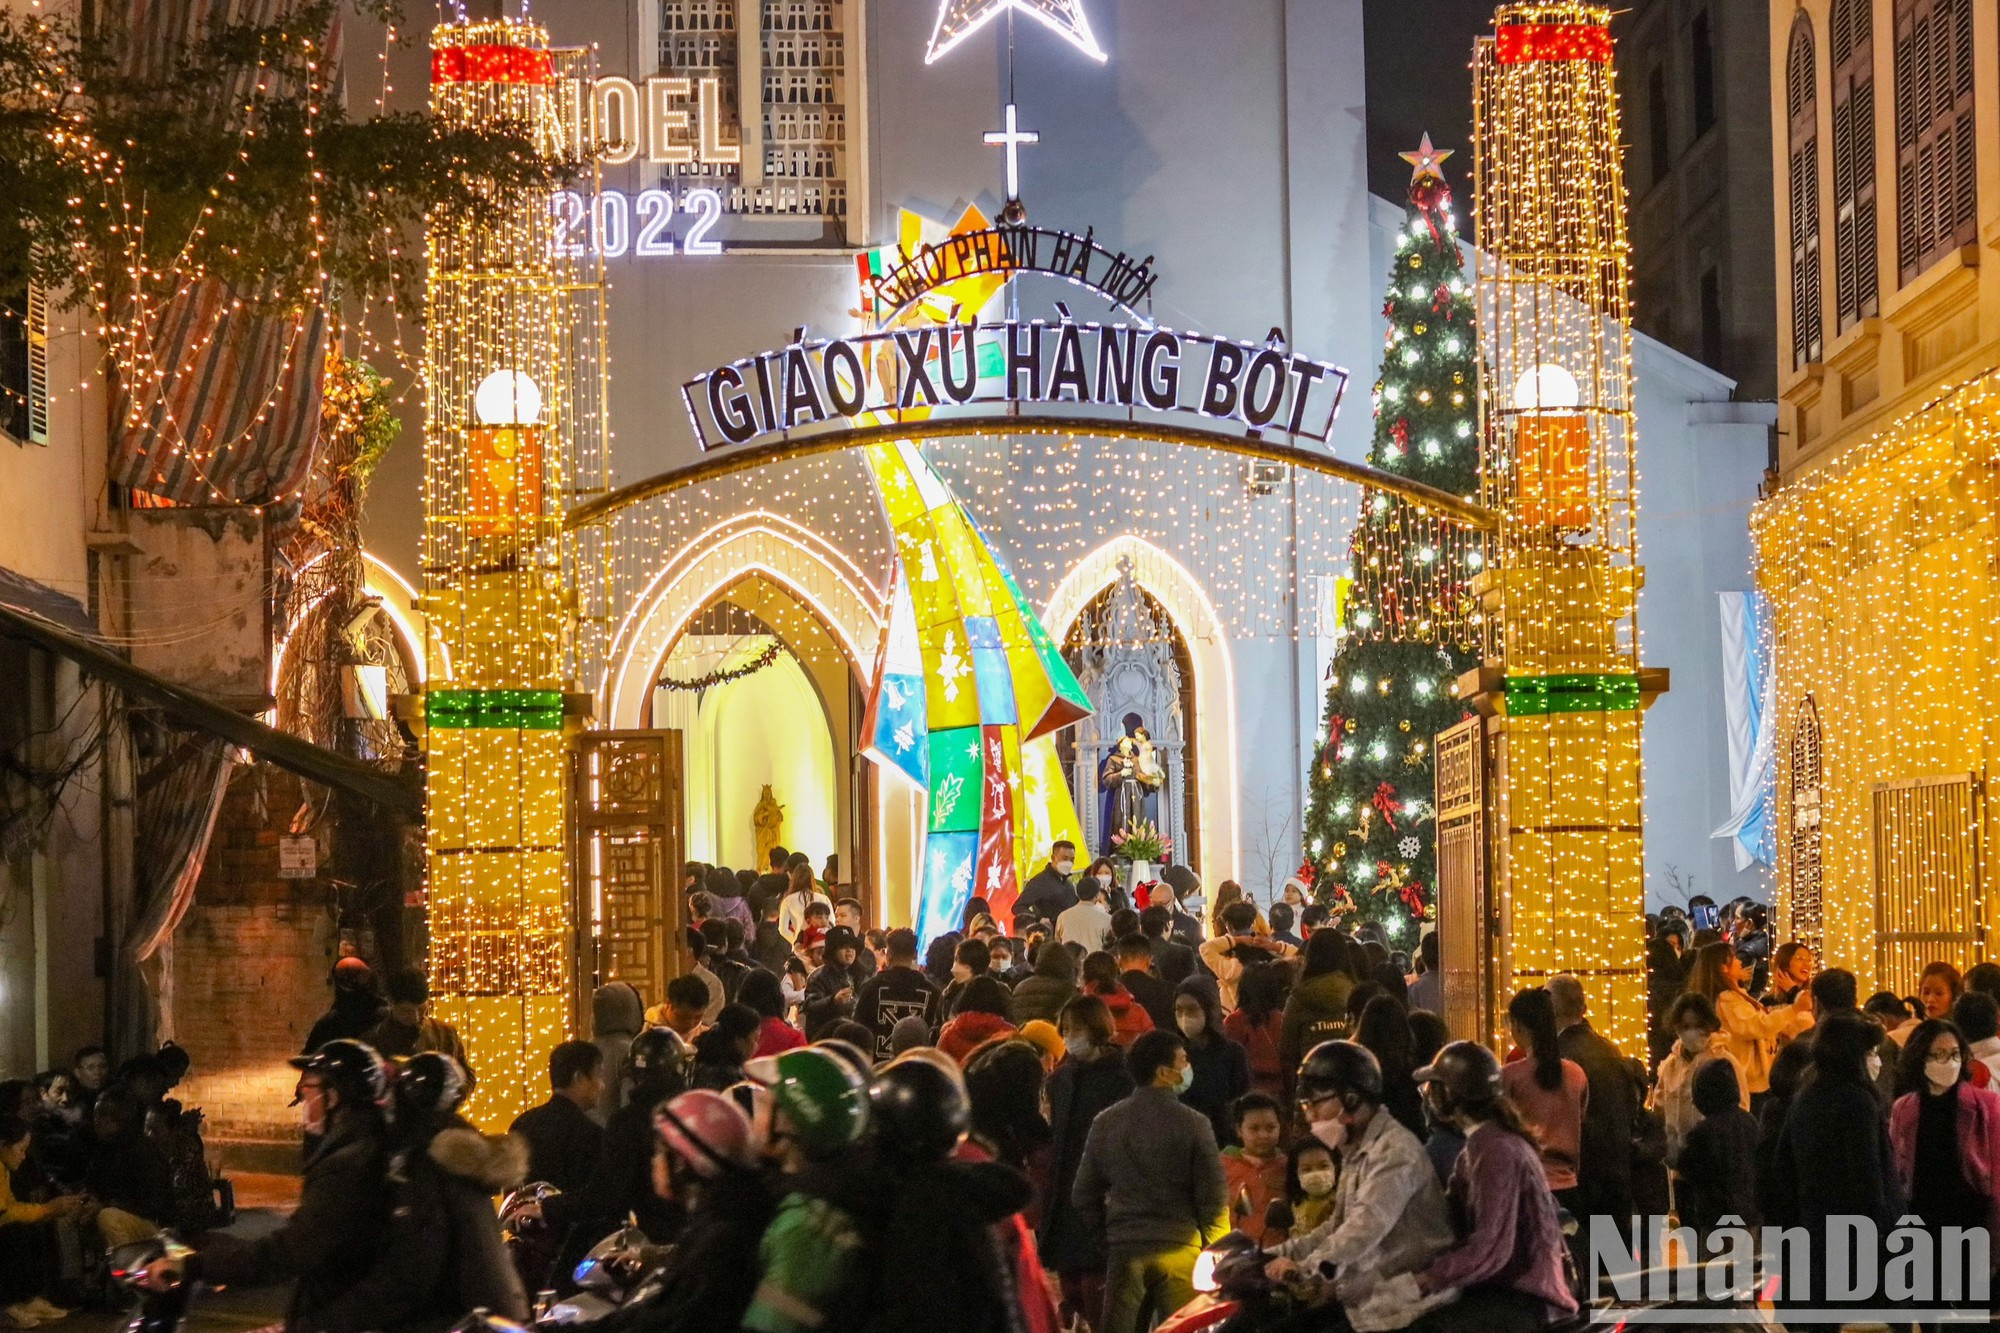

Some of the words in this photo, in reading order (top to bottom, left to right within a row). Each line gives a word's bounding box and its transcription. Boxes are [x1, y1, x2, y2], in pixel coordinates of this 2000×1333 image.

[526, 76, 740, 164] NOEL
[547, 188, 723, 259] 2022
[1050, 225, 1094, 283] HÀ
[707, 325, 865, 444] GIÁO
[894, 302, 978, 407] XỨ
[1004, 301, 1182, 412] HÀNG
[1199, 327, 1326, 440] BỘT
